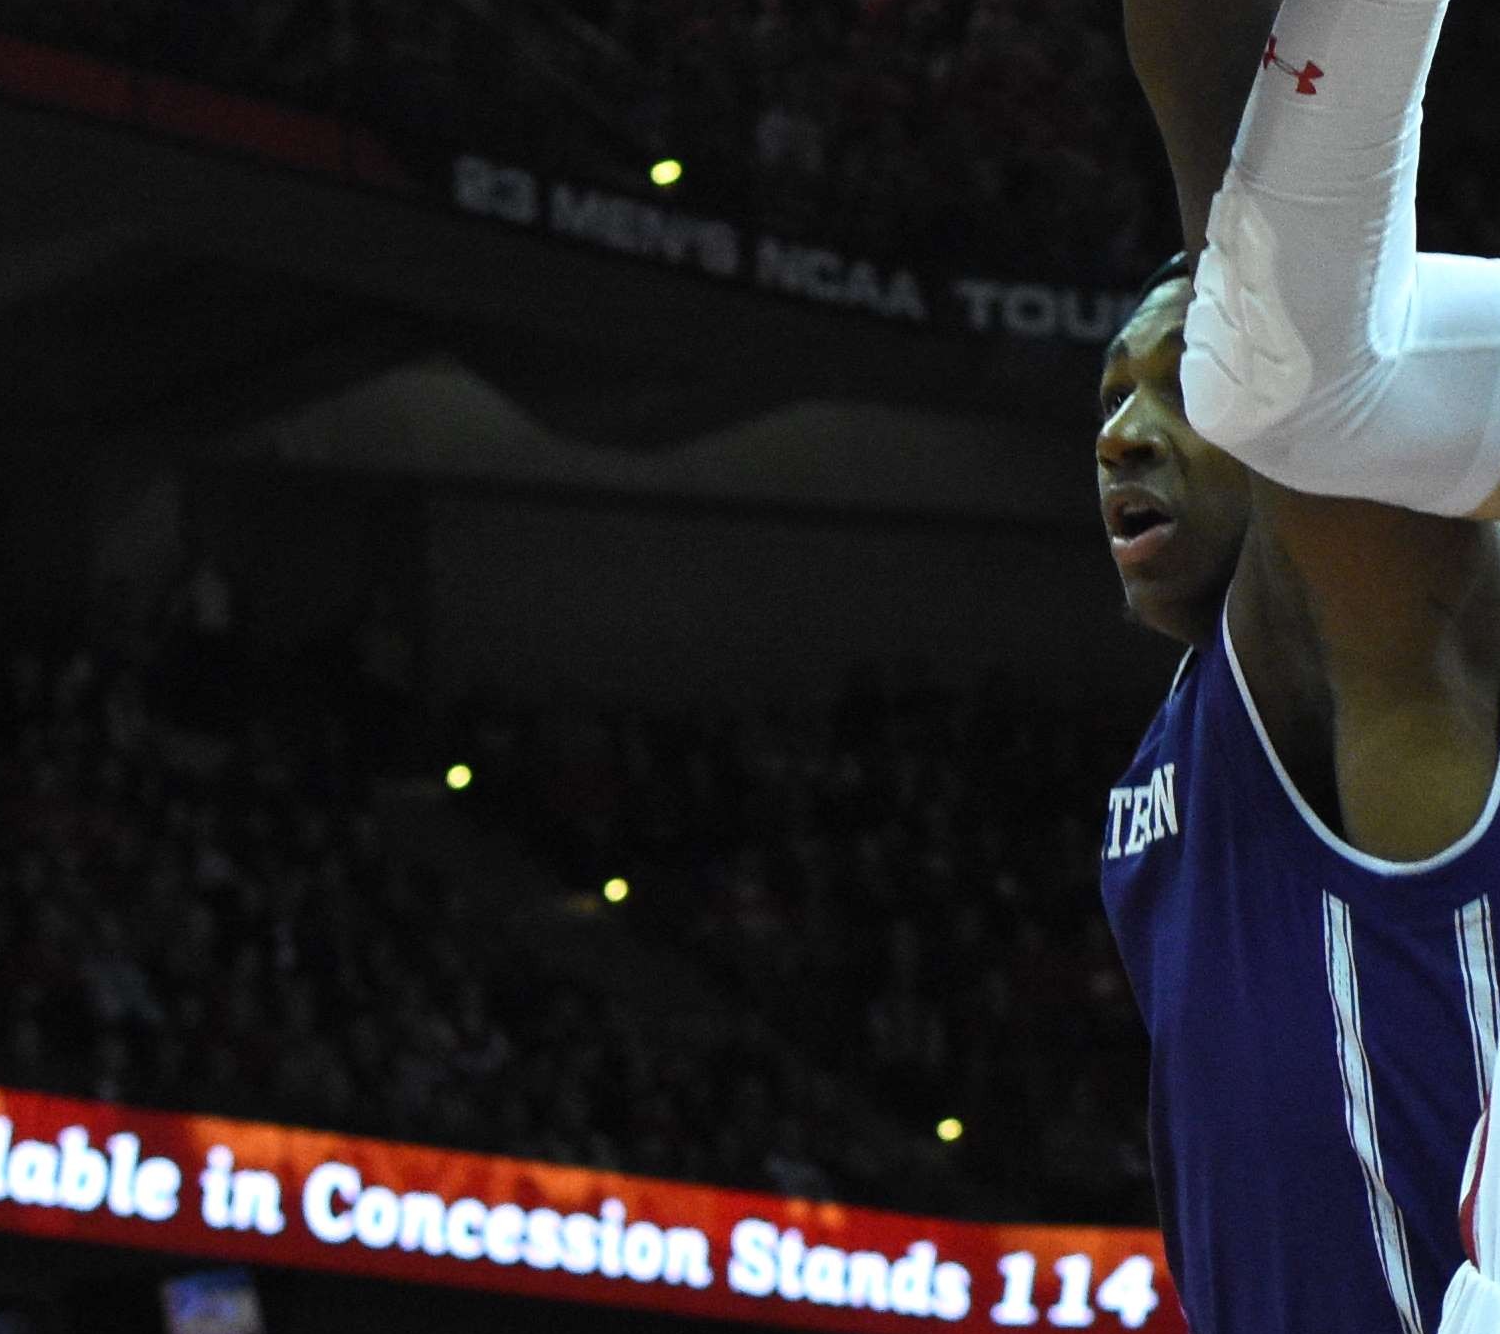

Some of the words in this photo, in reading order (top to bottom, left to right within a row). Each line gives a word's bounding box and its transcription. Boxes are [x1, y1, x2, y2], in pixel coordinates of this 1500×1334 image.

[754, 233, 930, 322] NCAA
[199, 1144, 287, 1235] in
[301, 1161, 714, 1289] Concession
[726, 1217, 973, 1320] Stands
[990, 1249, 1159, 1329] 114
